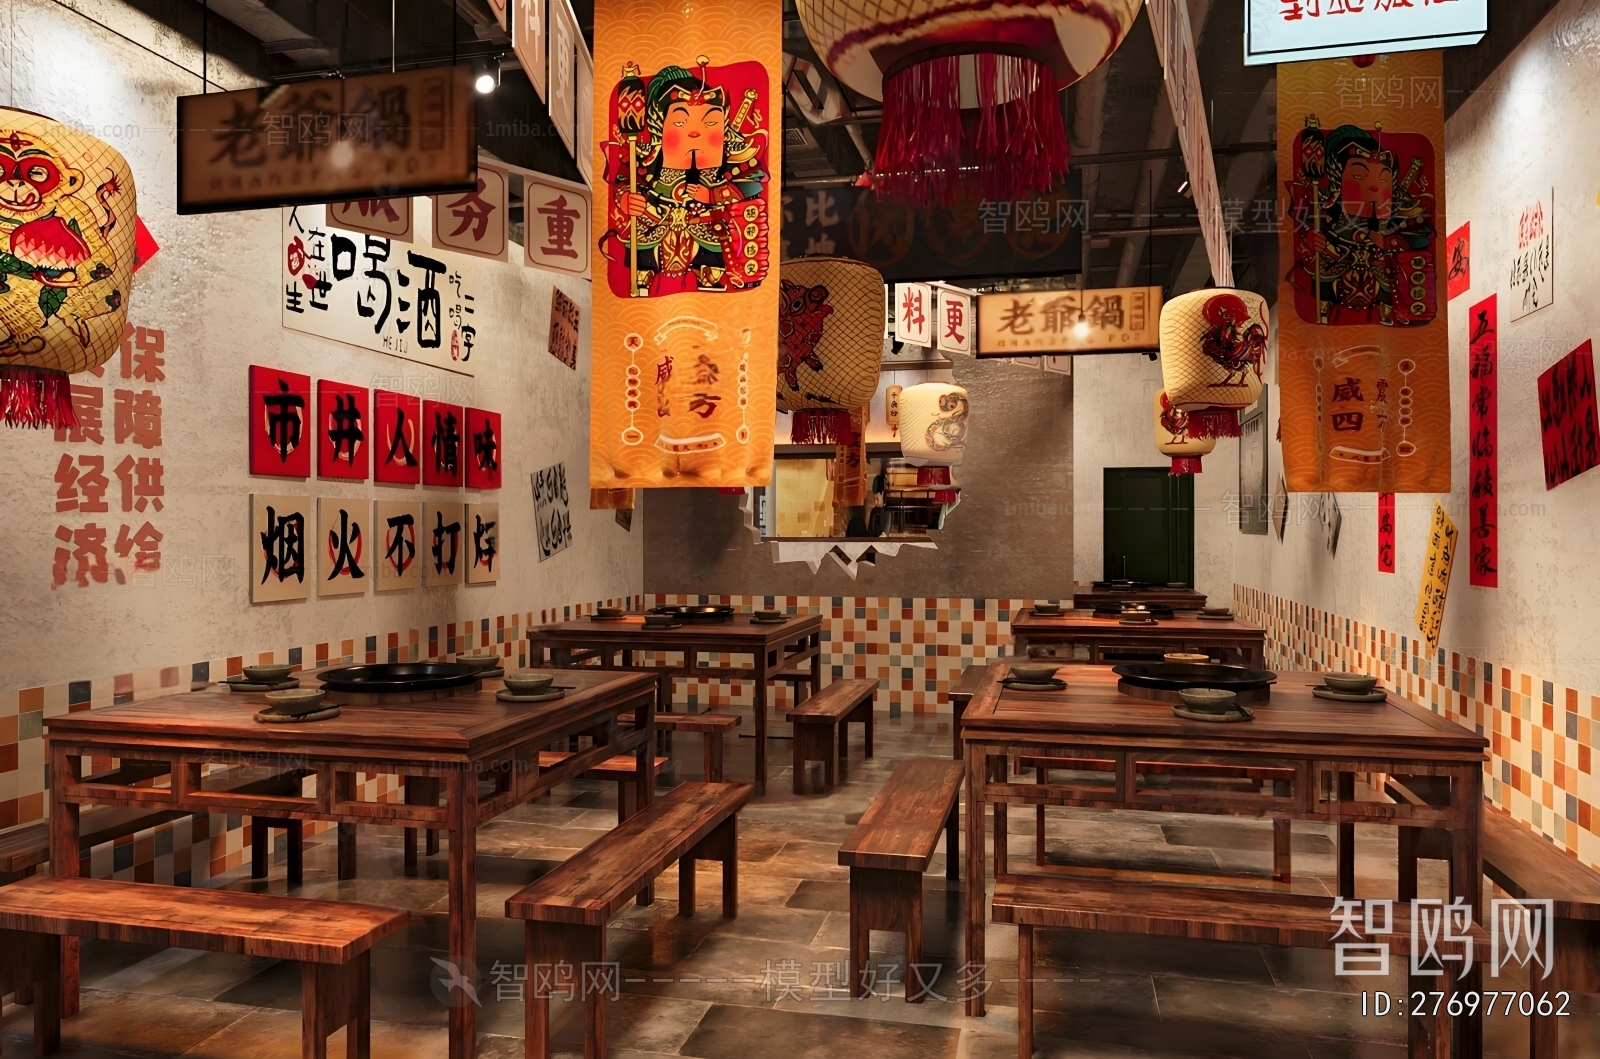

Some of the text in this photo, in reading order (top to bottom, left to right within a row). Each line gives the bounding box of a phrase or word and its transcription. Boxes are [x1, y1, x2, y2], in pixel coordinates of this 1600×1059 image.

[331, 233, 447, 348] 喝酒
[902, 287, 965, 344] 料更
[51, 365, 109, 589] 展经济
[113, 322, 166, 572] 保障供给
[263, 378, 498, 477] 市井人情味
[261, 506, 497, 586] 烟火不打烊
